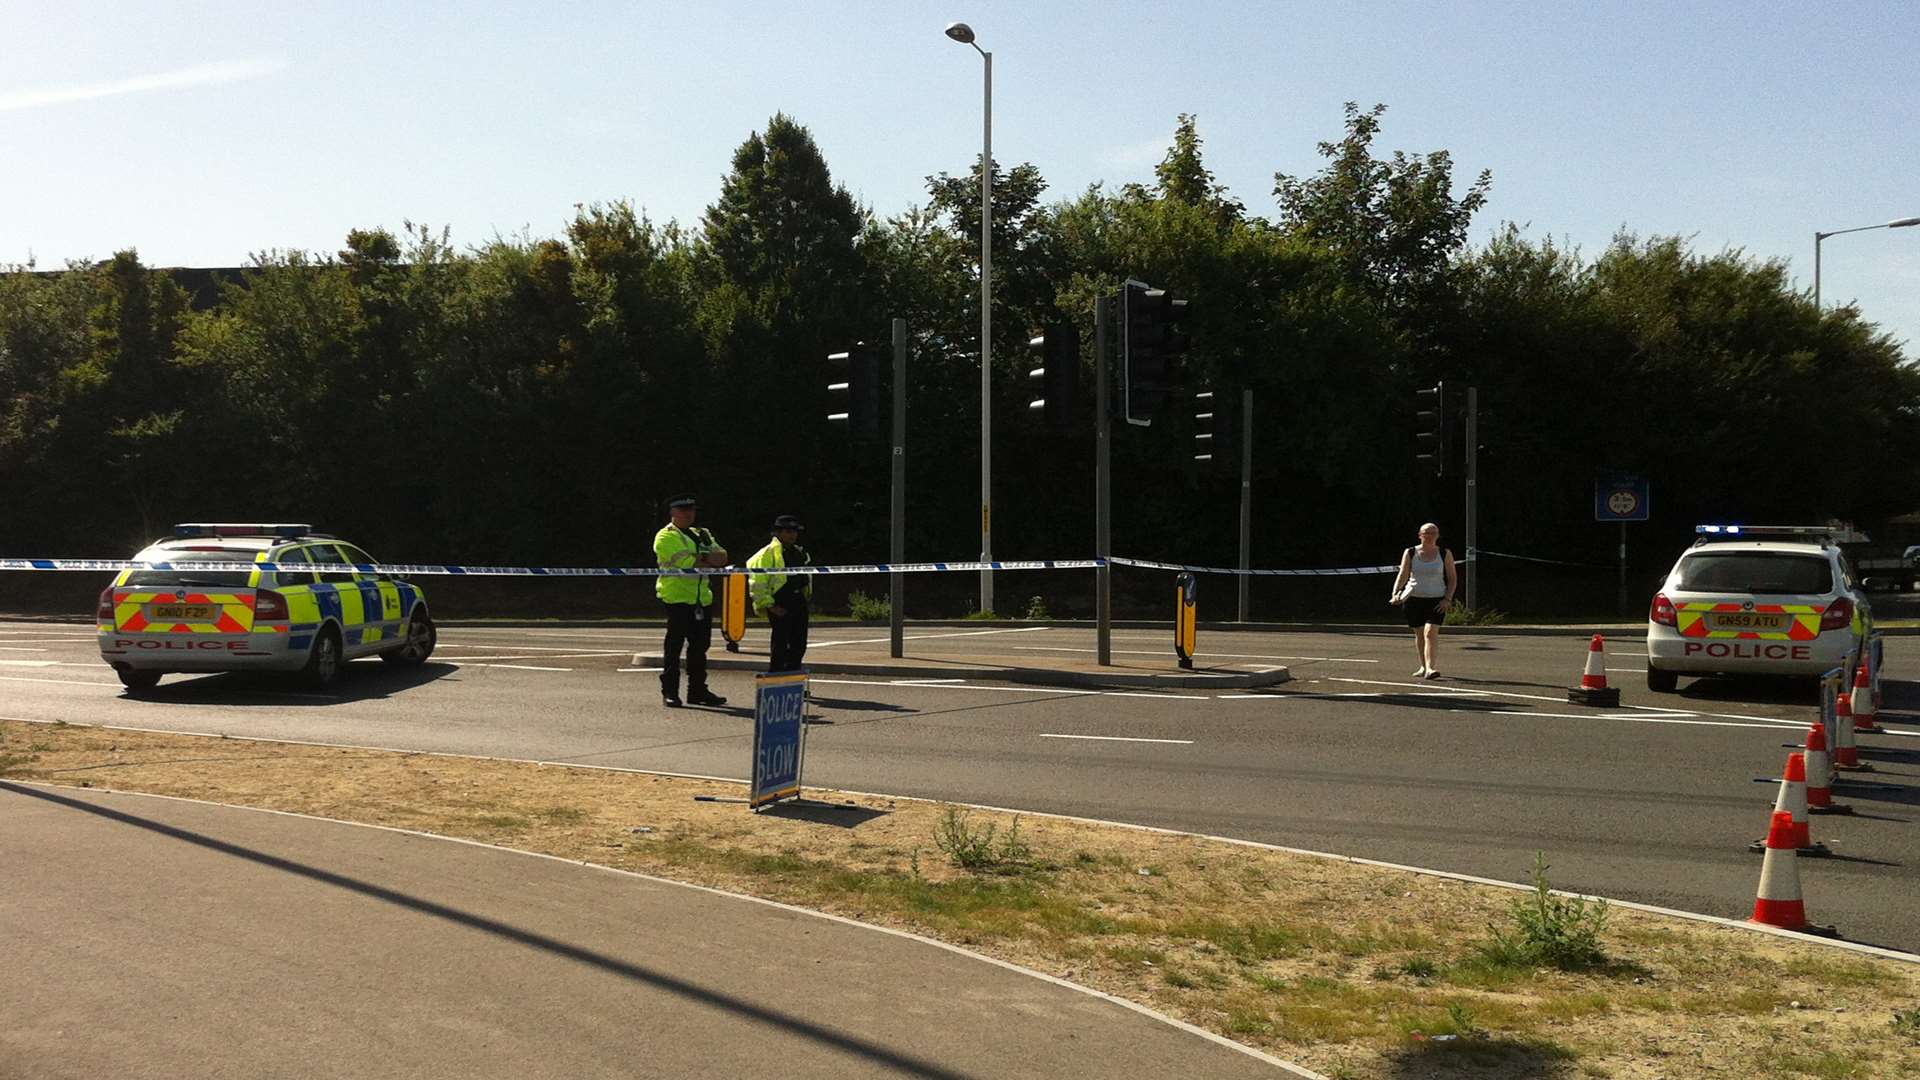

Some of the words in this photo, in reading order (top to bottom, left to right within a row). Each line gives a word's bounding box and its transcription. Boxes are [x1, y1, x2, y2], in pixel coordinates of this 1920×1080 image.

[1717, 615, 1750, 626] GN59
[1753, 616, 1779, 627] ATU
[115, 640, 249, 650] POLICE
[1684, 642, 1811, 660] POLICE
[762, 693, 801, 724] POLICE
[759, 744, 796, 781] SLOW
